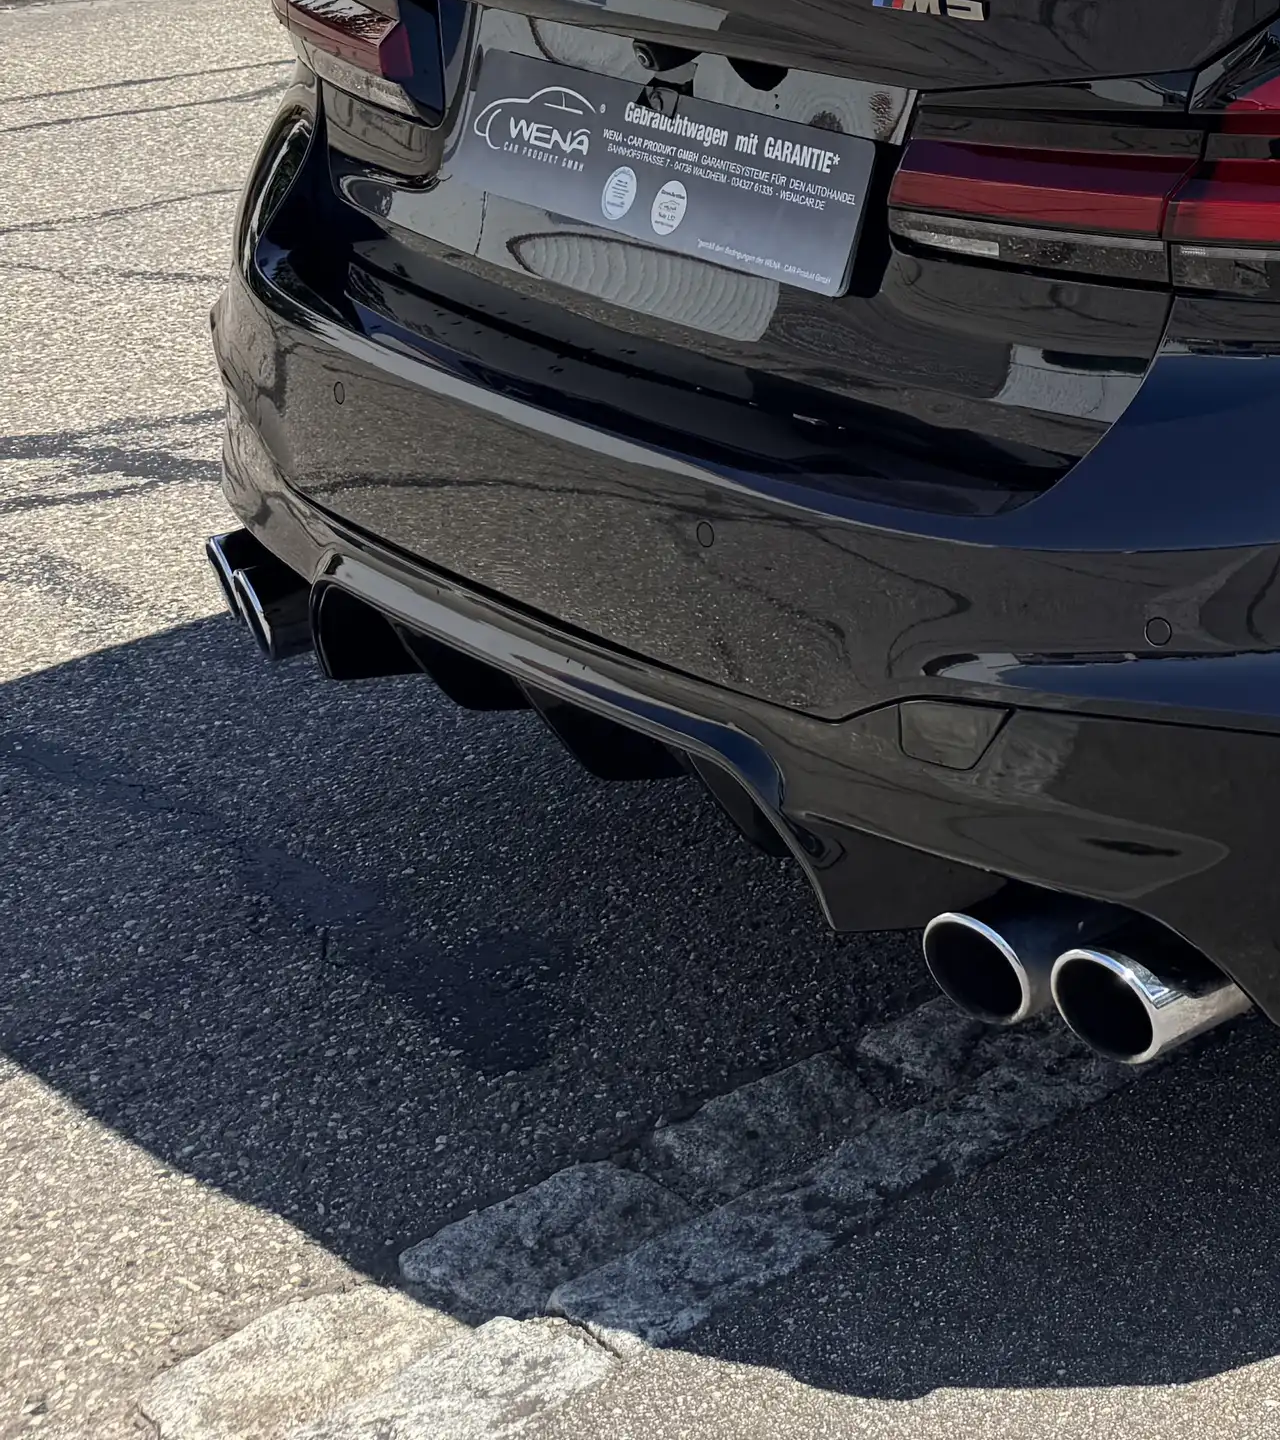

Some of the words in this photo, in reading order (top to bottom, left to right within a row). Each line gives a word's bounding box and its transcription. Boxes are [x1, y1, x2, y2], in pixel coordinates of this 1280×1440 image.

[624, 101, 729, 148] Gebrauchtwagen
[734, 132, 759, 156] mit
[503, 141, 519, 154] CAR
[521, 146, 559, 165] PRODUKT
[603, 128, 623, 143] WENA
[627, 135, 642, 148] CAR
[642, 139, 677, 157] PRODUKT
[677, 148, 700, 163] GMBH
[701, 154, 770, 183] GARANTIESYSTEME
[770, 172, 787, 187] FÜR
[789, 178, 806, 192] DEN
[805, 182, 856, 205] AUTOHANDEL
[692, 165, 728, 183] WALDHEIM
